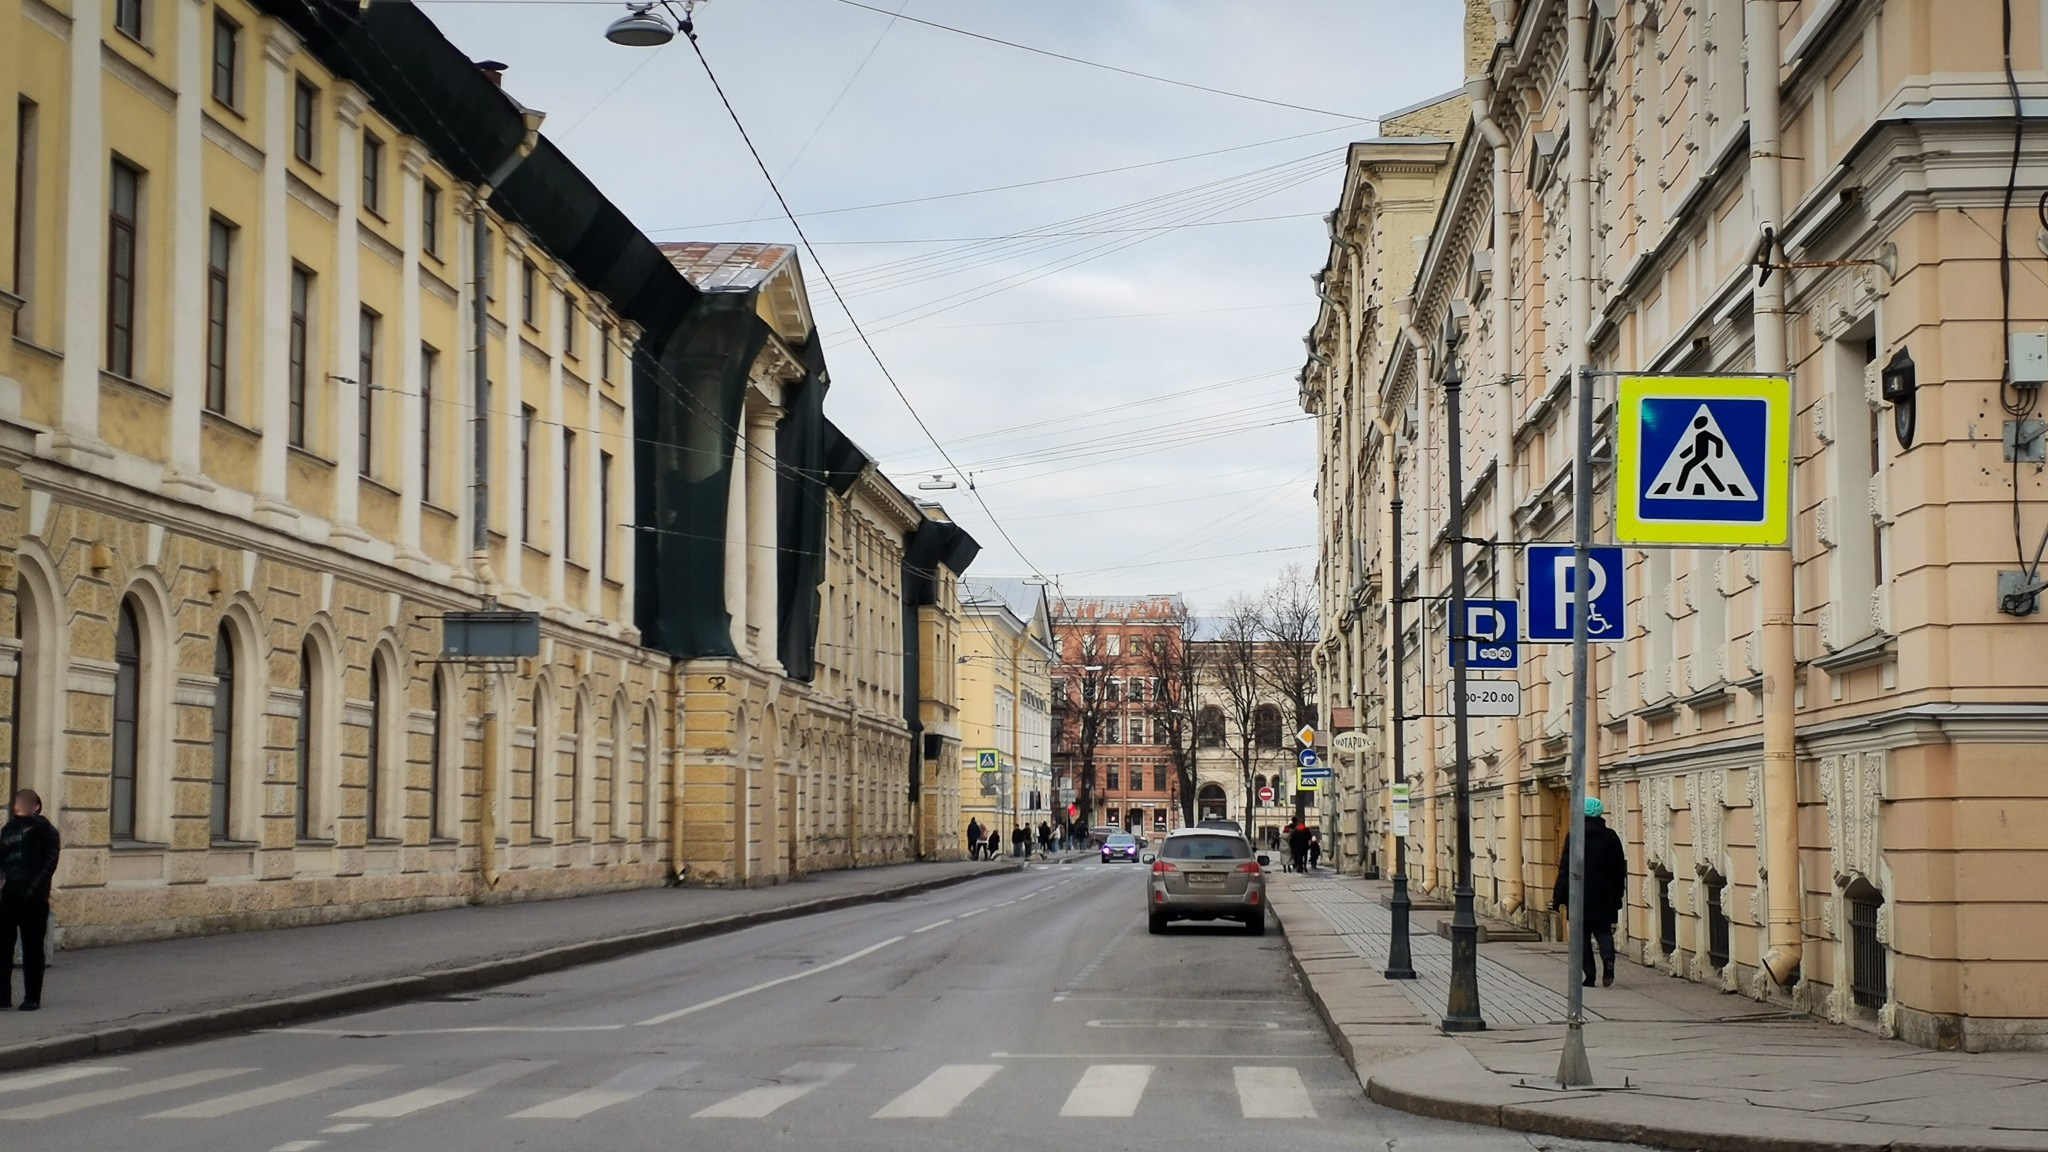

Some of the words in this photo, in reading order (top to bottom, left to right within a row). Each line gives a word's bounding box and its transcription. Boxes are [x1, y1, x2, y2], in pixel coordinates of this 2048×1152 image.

[1890, 376, 1899, 391] 4
[1554, 555, 1607, 630] P
[1467, 607, 1506, 661] P
[1499, 649, 1511, 658] 20
